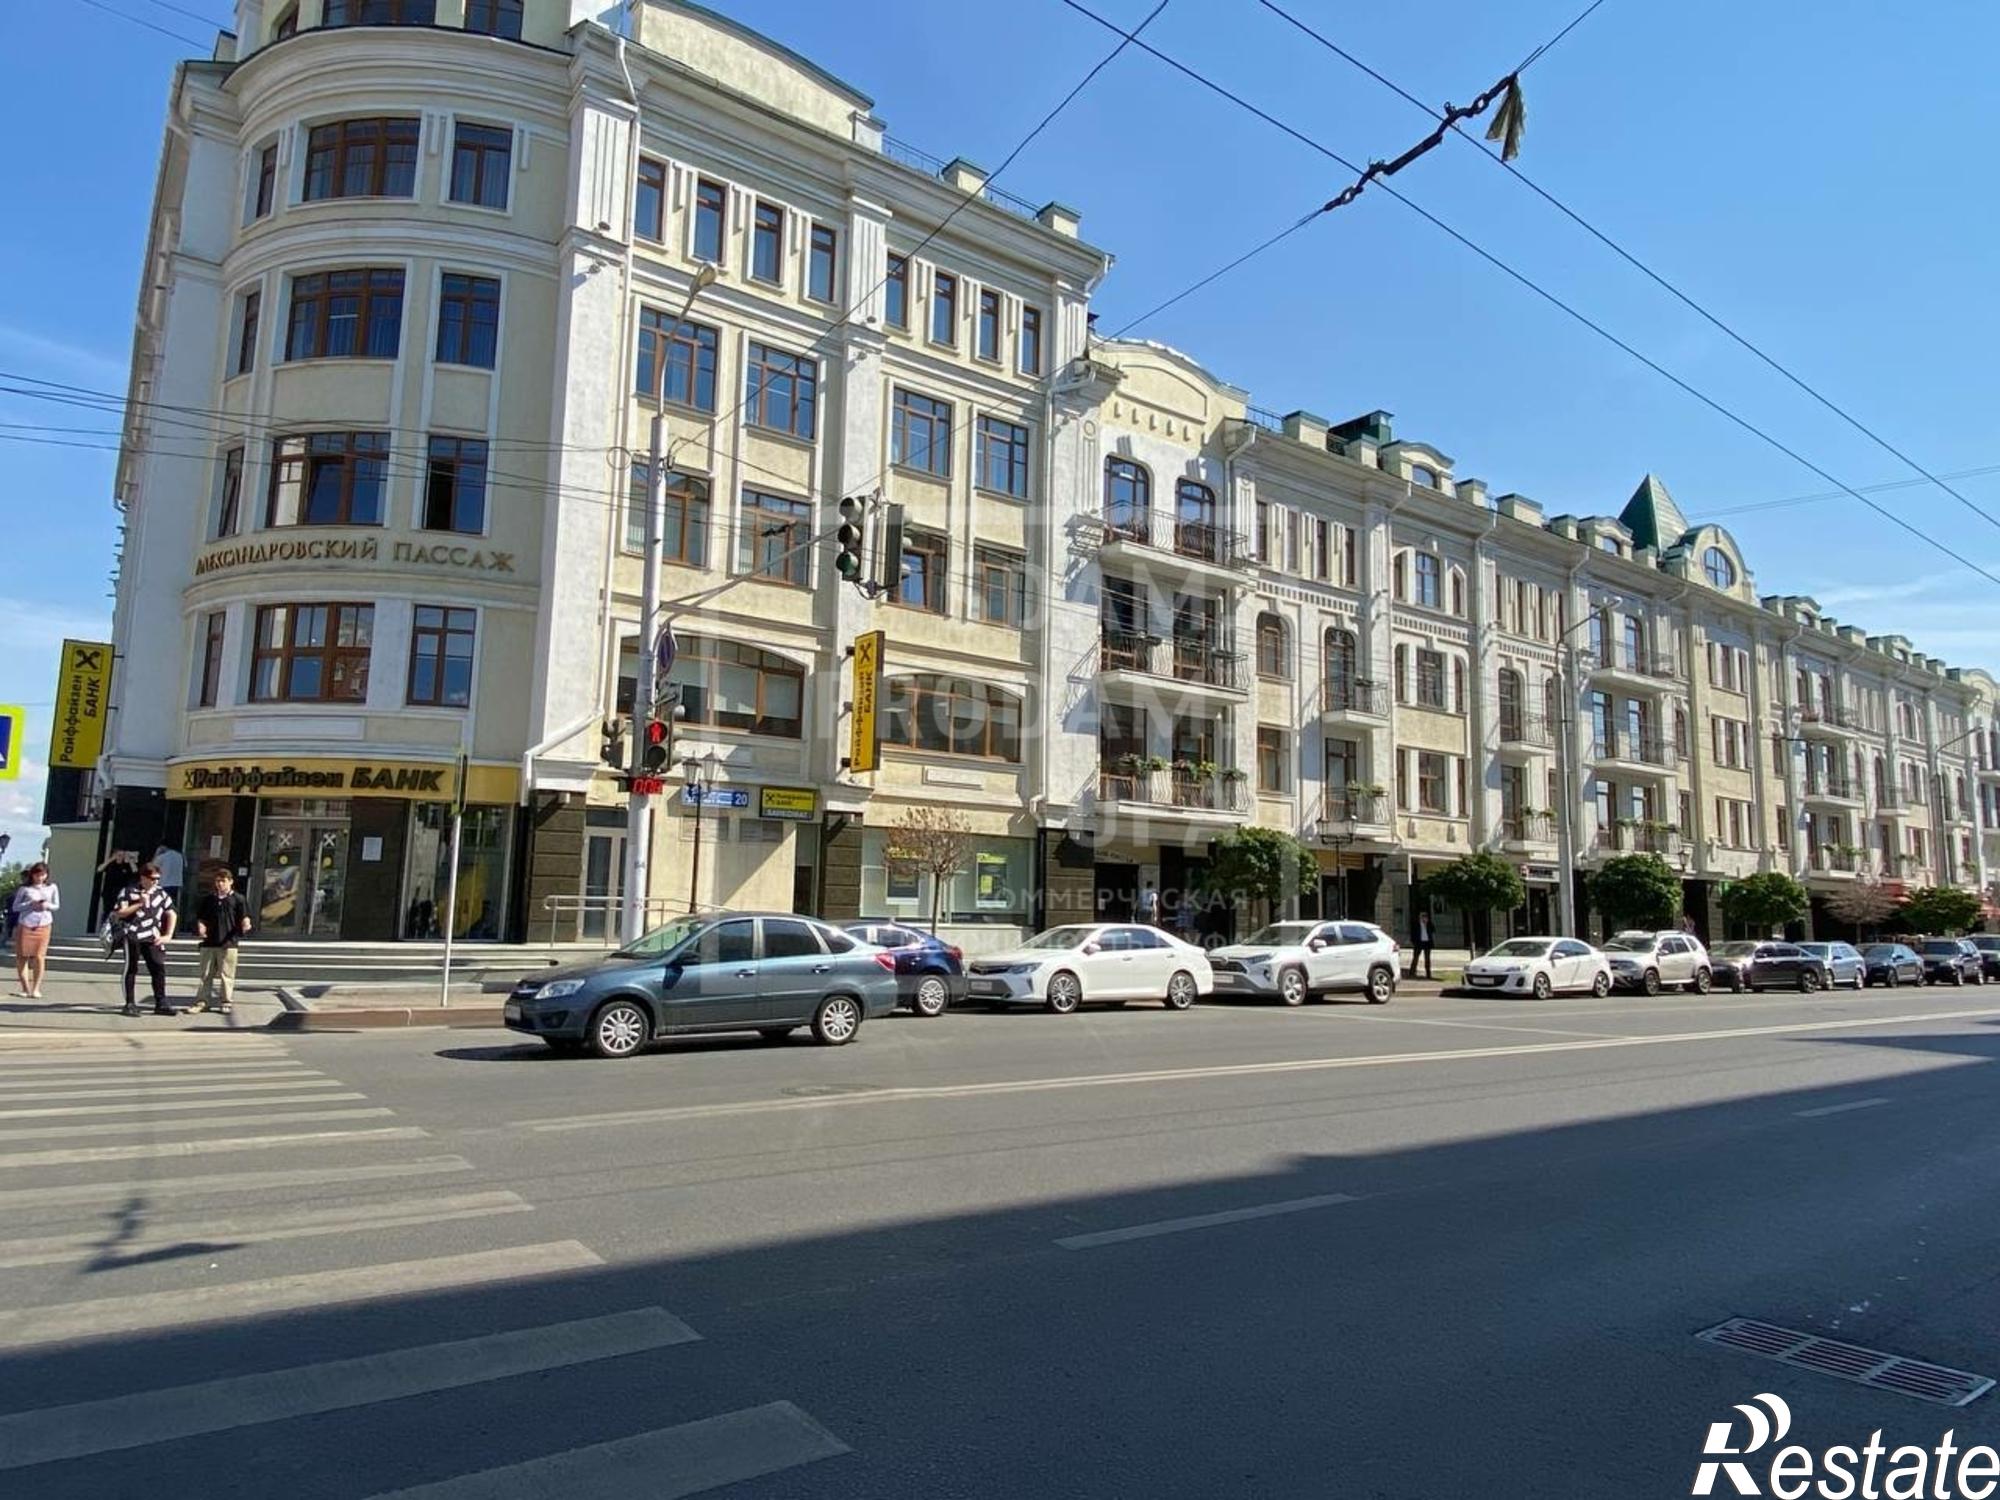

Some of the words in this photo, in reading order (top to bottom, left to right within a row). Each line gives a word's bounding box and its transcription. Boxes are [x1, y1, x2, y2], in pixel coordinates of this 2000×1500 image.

[393, 541, 516, 573] ПАССАЖ
[84, 676, 100, 718] БАНК
[350, 766, 446, 792] БАНК
[735, 793, 748, 805] 20
